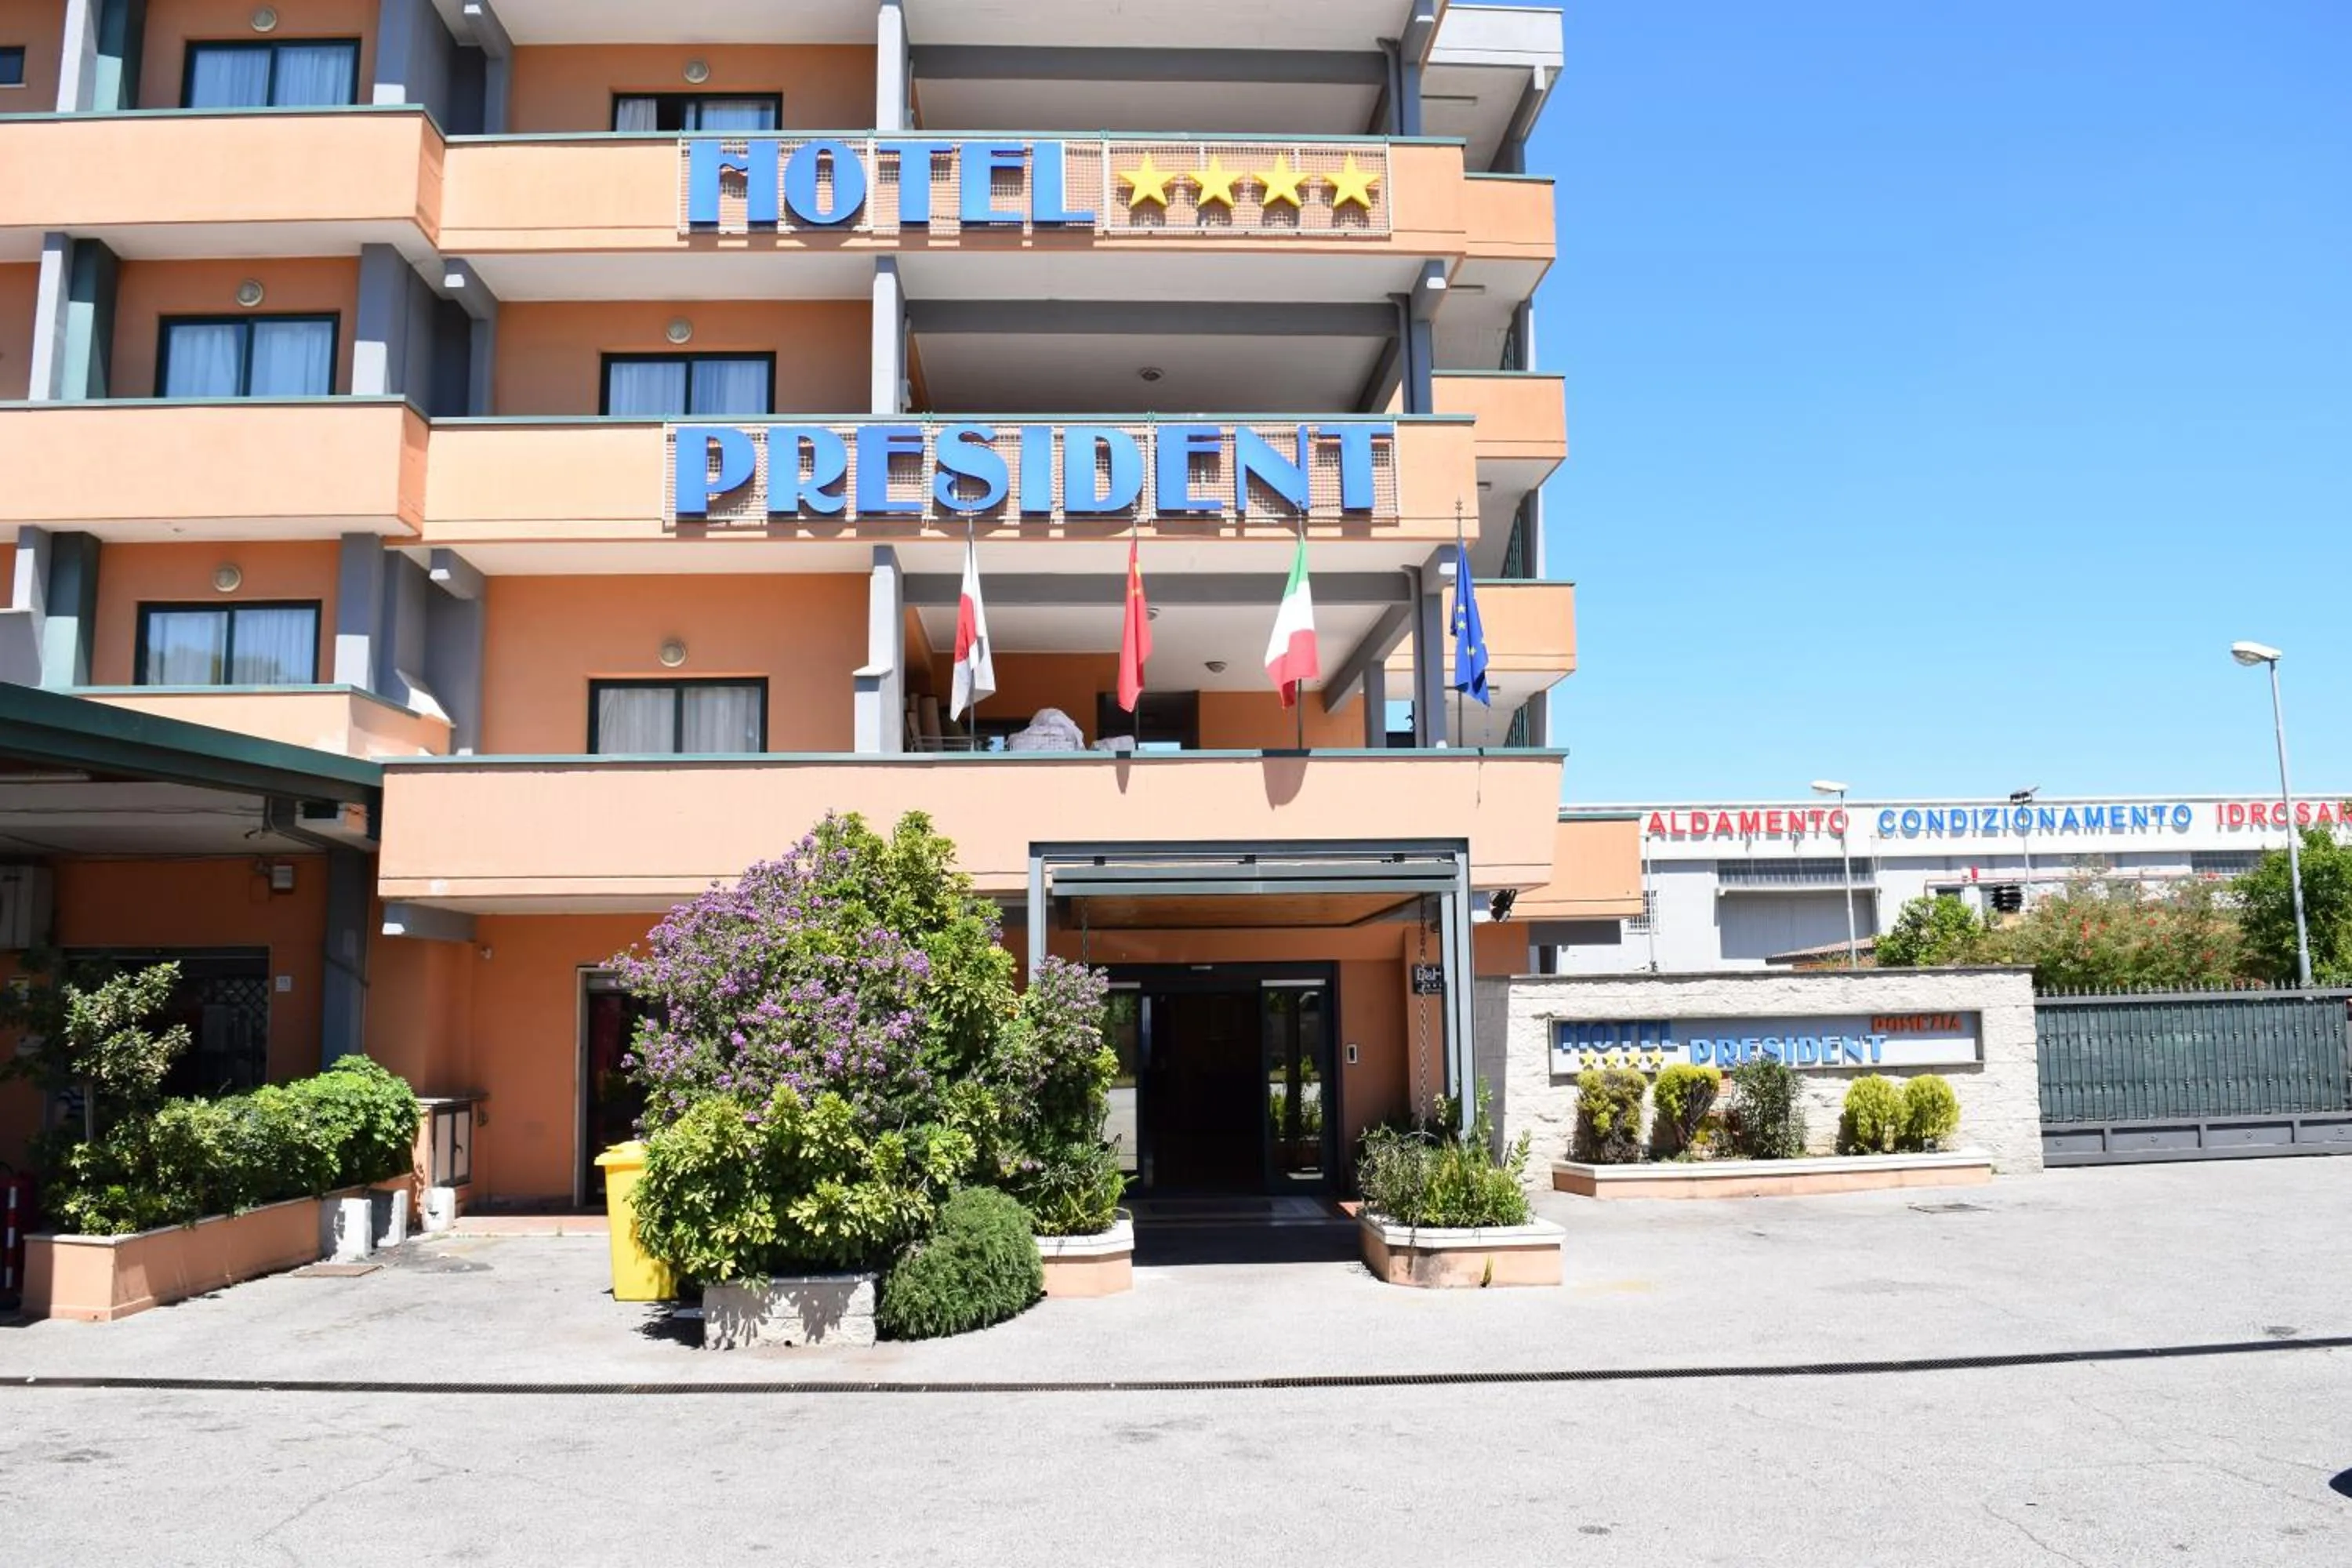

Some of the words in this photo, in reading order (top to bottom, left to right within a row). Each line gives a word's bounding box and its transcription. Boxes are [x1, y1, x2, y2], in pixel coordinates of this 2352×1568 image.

[689, 140, 1094, 224] HOTEL
[675, 423, 1393, 514] PRESIDENT
[1877, 804, 2194, 833] CONDIZIONAMENTO
[1562, 1021, 1679, 1053] HOTEL
[1690, 1034, 1887, 1065] PRESIDENT
